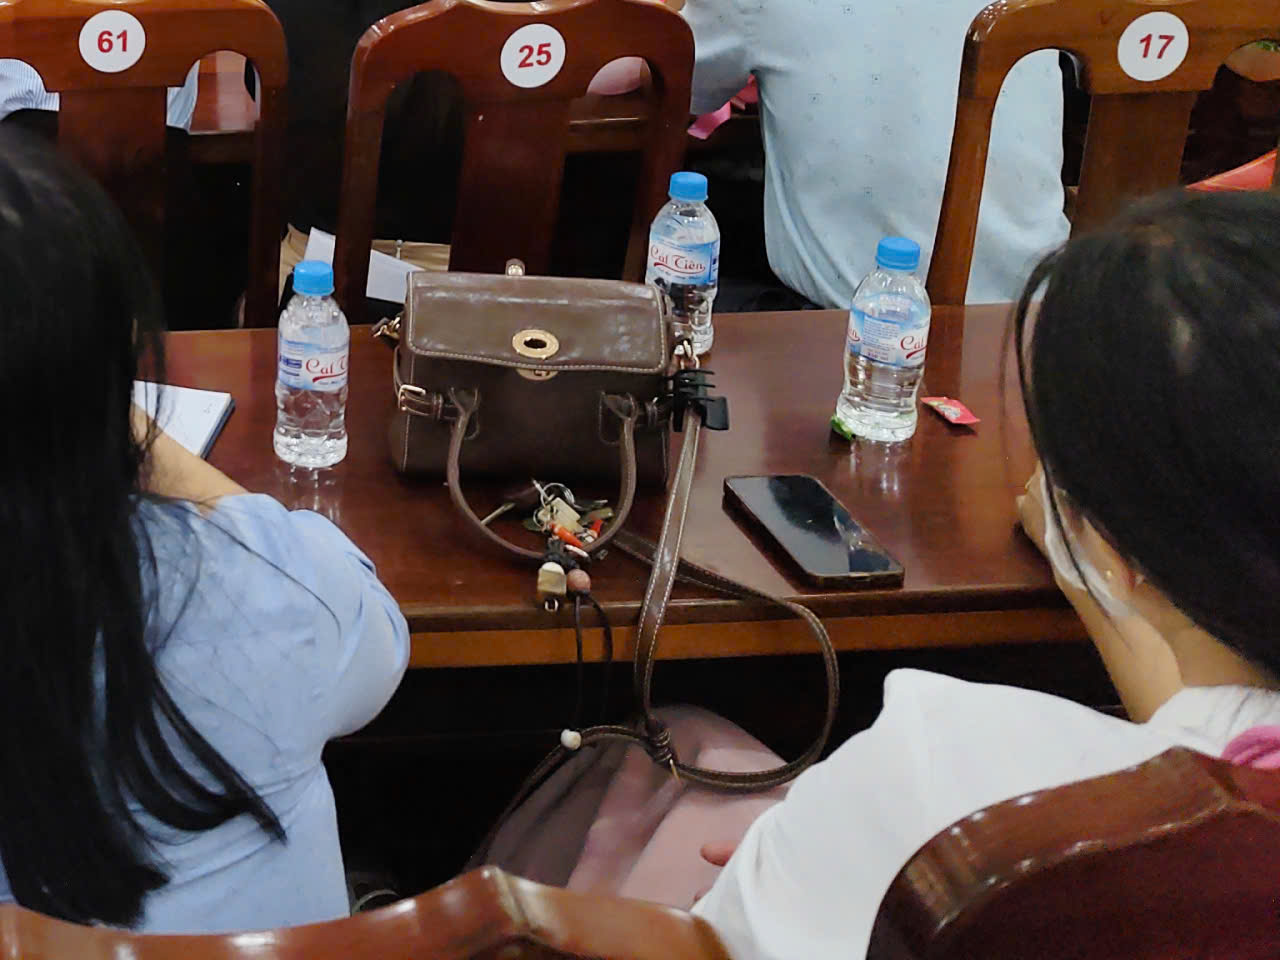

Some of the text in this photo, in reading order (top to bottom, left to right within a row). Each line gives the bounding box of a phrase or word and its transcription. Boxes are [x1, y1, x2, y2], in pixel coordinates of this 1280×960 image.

[97, 29, 128, 54] 61
[1139, 33, 1175, 60] 17
[518, 42, 552, 69] 25
